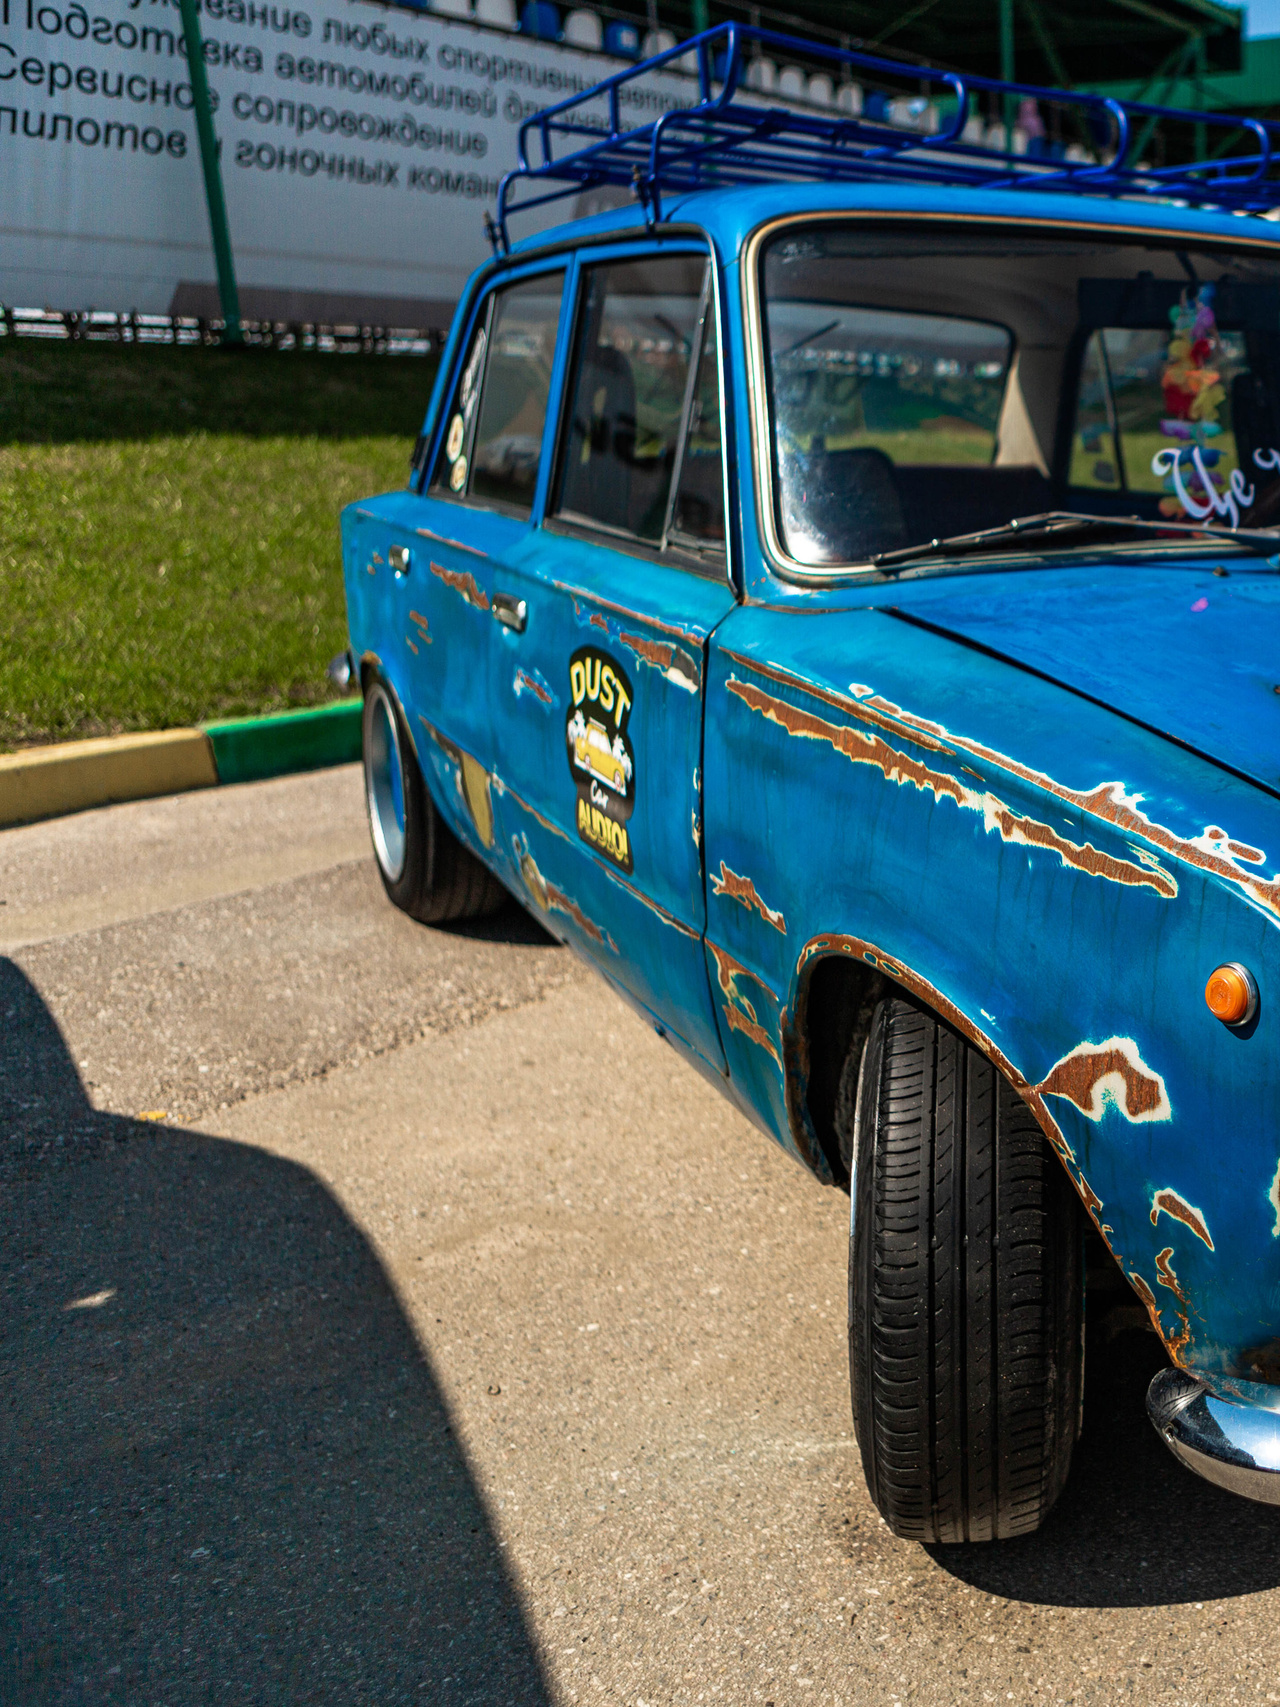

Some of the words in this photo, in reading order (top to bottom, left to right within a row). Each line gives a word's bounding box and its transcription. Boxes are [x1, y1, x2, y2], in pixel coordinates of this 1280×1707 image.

[275, 52, 498, 118] автомобилей
[232, 90, 489, 159] сопровождение
[234, 139, 400, 188] гоночных
[570, 656, 632, 729] DUST
